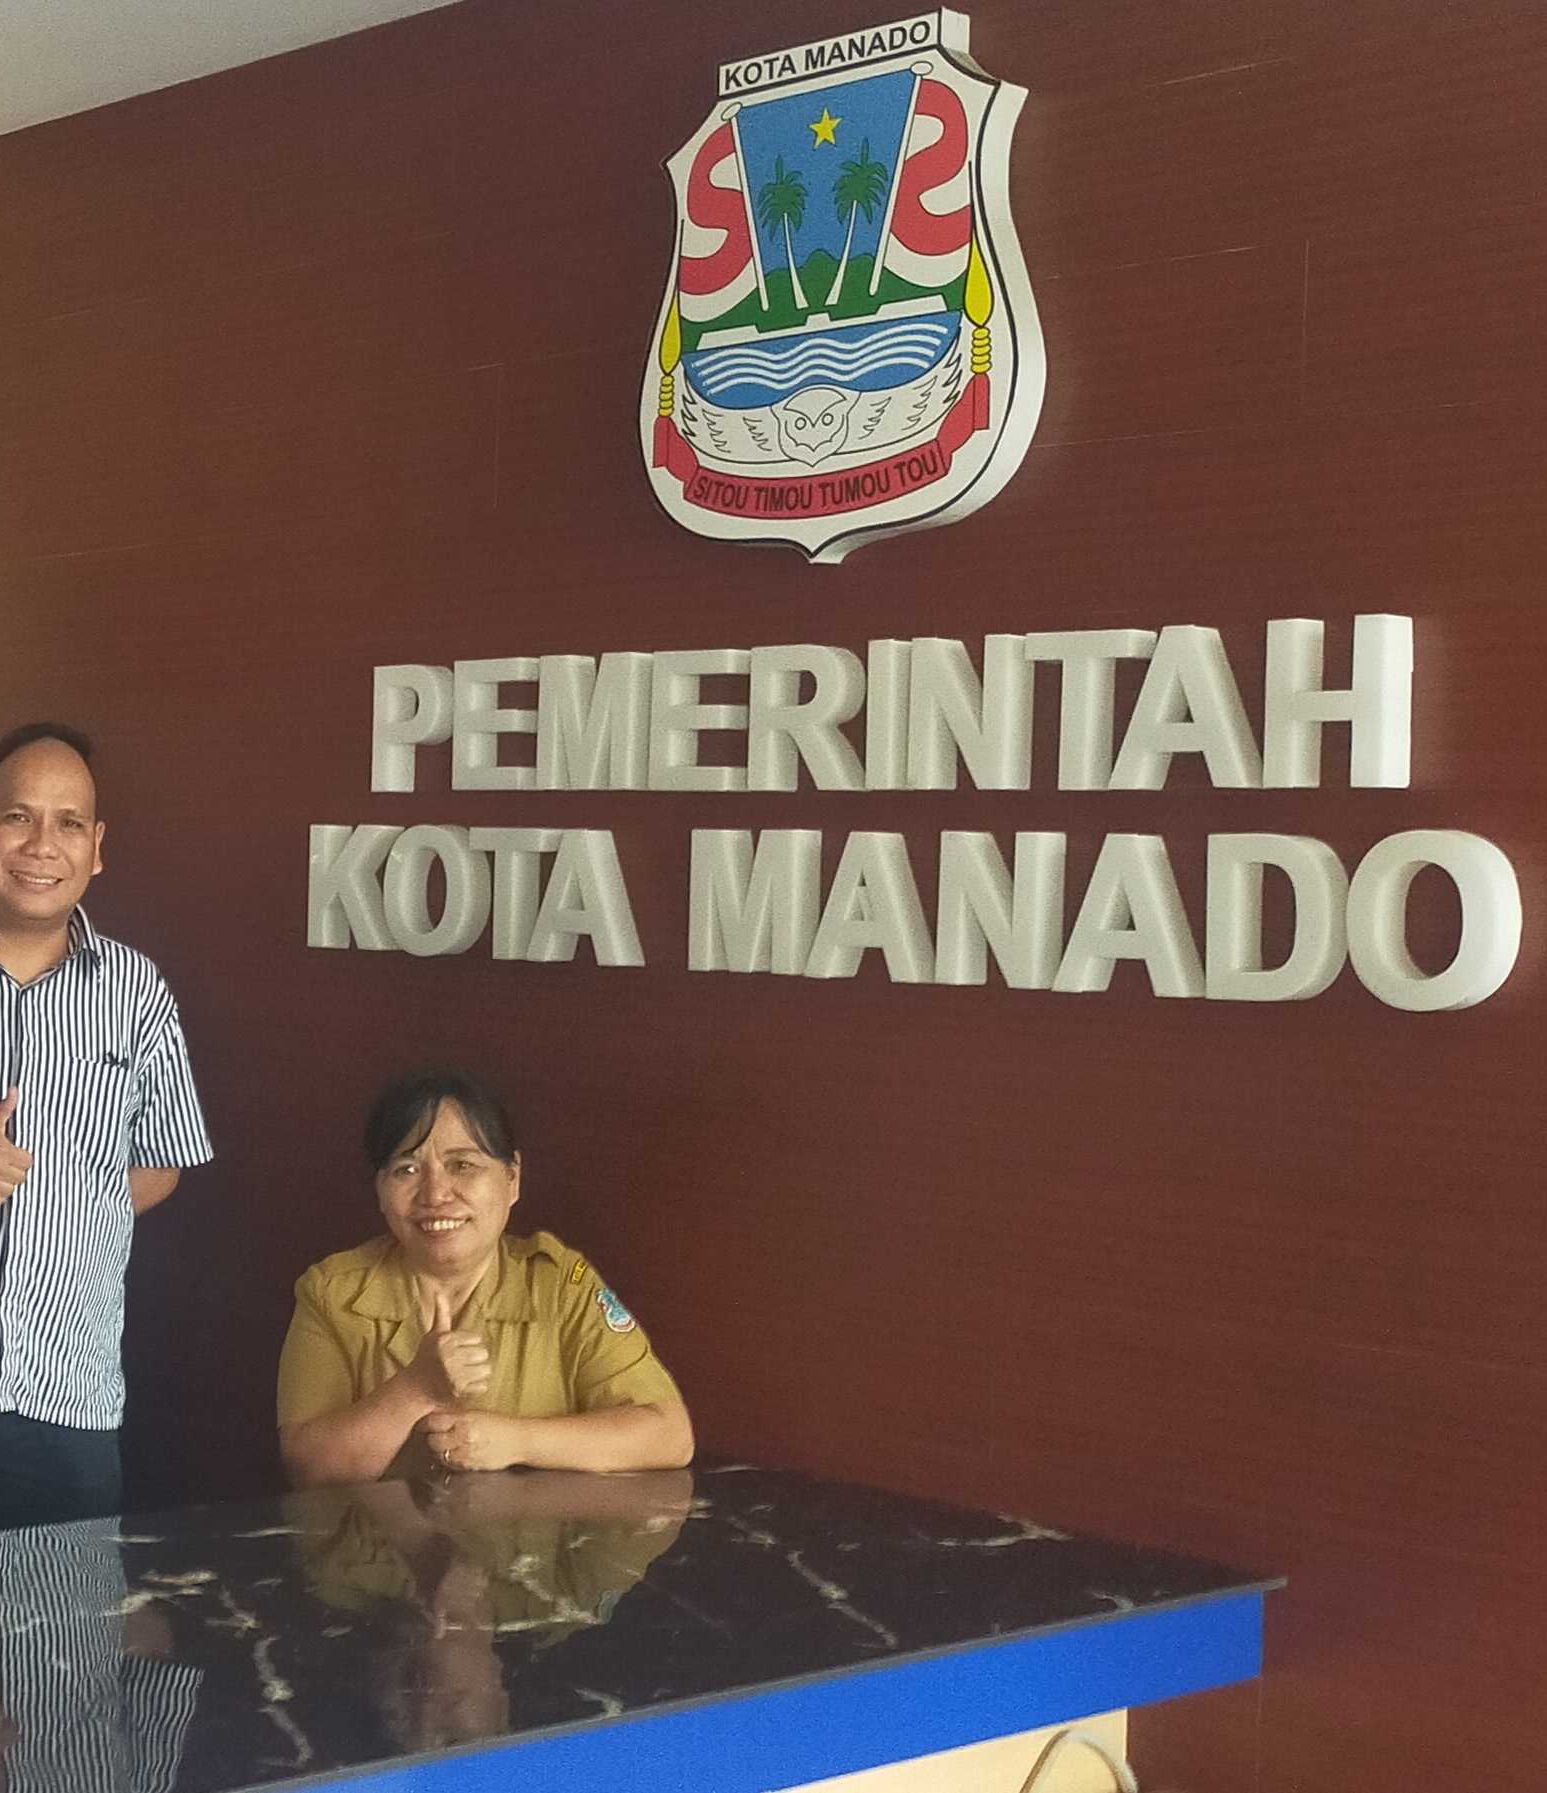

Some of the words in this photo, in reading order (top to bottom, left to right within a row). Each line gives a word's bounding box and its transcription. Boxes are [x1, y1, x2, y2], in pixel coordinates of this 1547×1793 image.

[724, 53, 798, 91] KOTA
[803, 20, 930, 72] MANADO
[693, 476, 750, 511] SITOU
[754, 484, 813, 513] TIMOU
[819, 468, 891, 506] TUMOU
[893, 453, 939, 483] TOU
[371, 614, 1414, 793] PEMERINTAH
[307, 824, 646, 968] KOTA
[687, 827, 1523, 1013] MANADO
